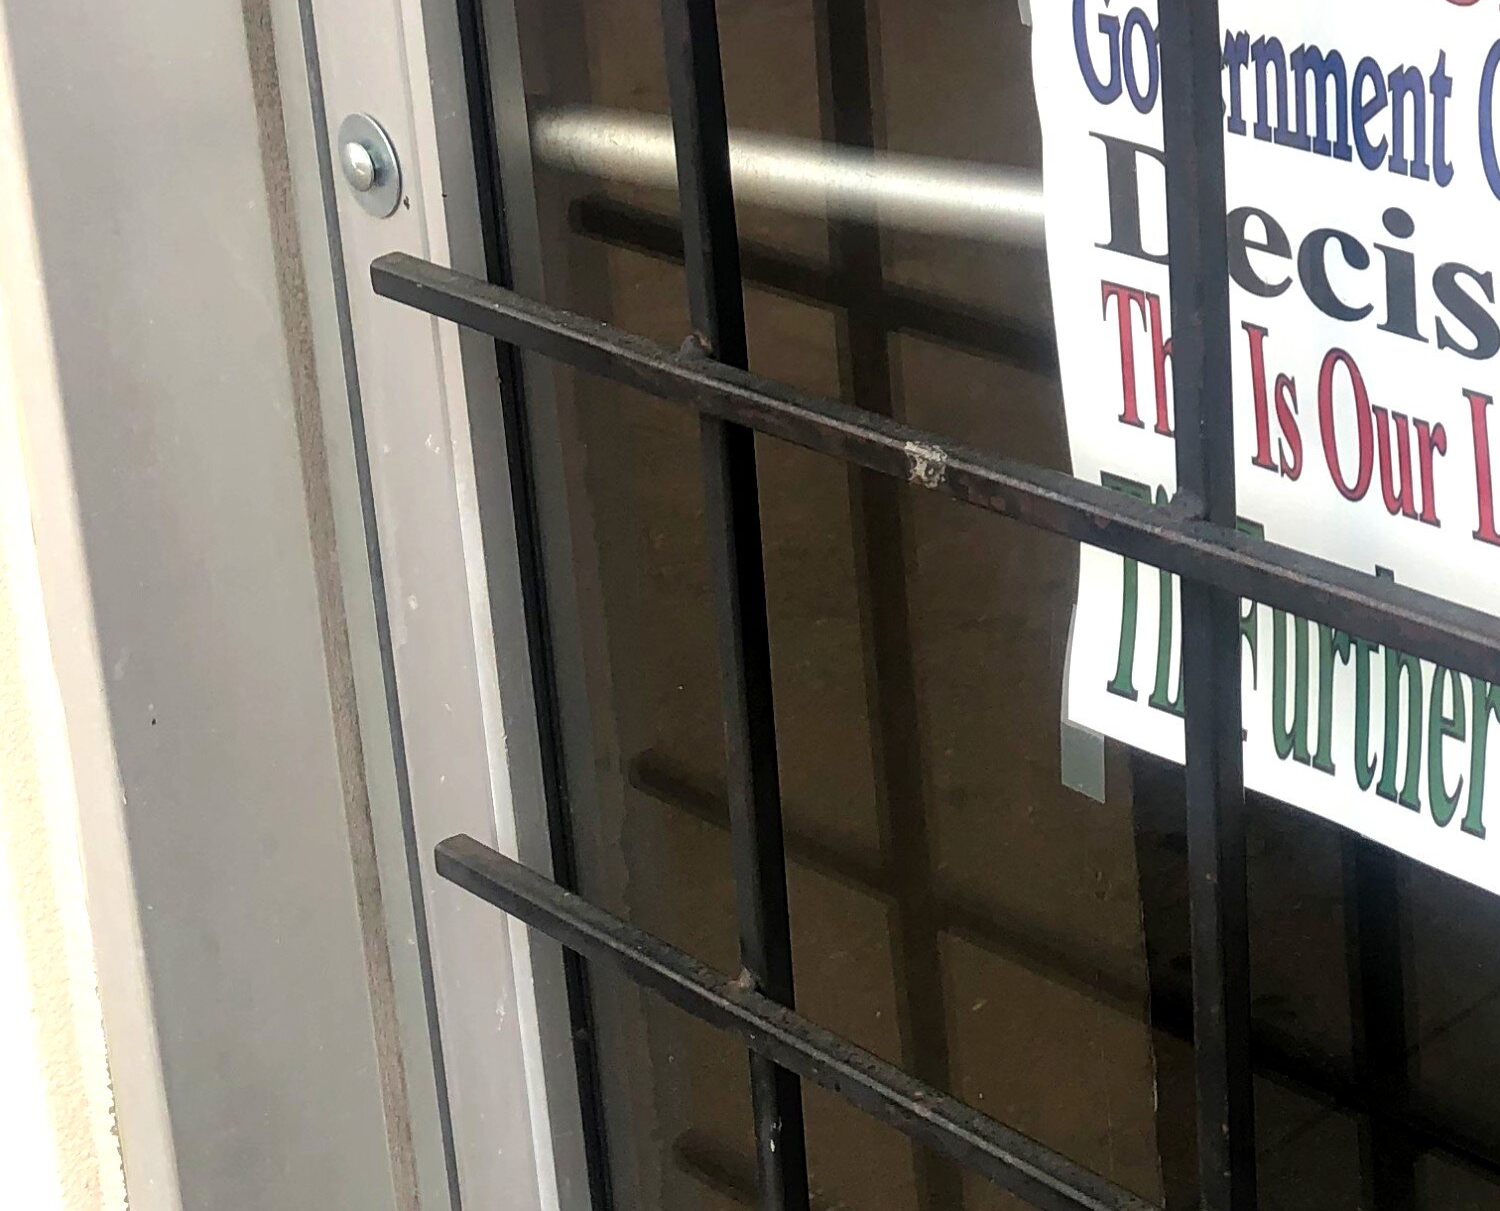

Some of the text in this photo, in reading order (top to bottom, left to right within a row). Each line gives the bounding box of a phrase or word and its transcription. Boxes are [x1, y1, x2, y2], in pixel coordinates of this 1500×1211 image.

[1101, 279, 1176, 439] Th
[1241, 322, 1305, 481] Is
[1318, 346, 1447, 528] Our
